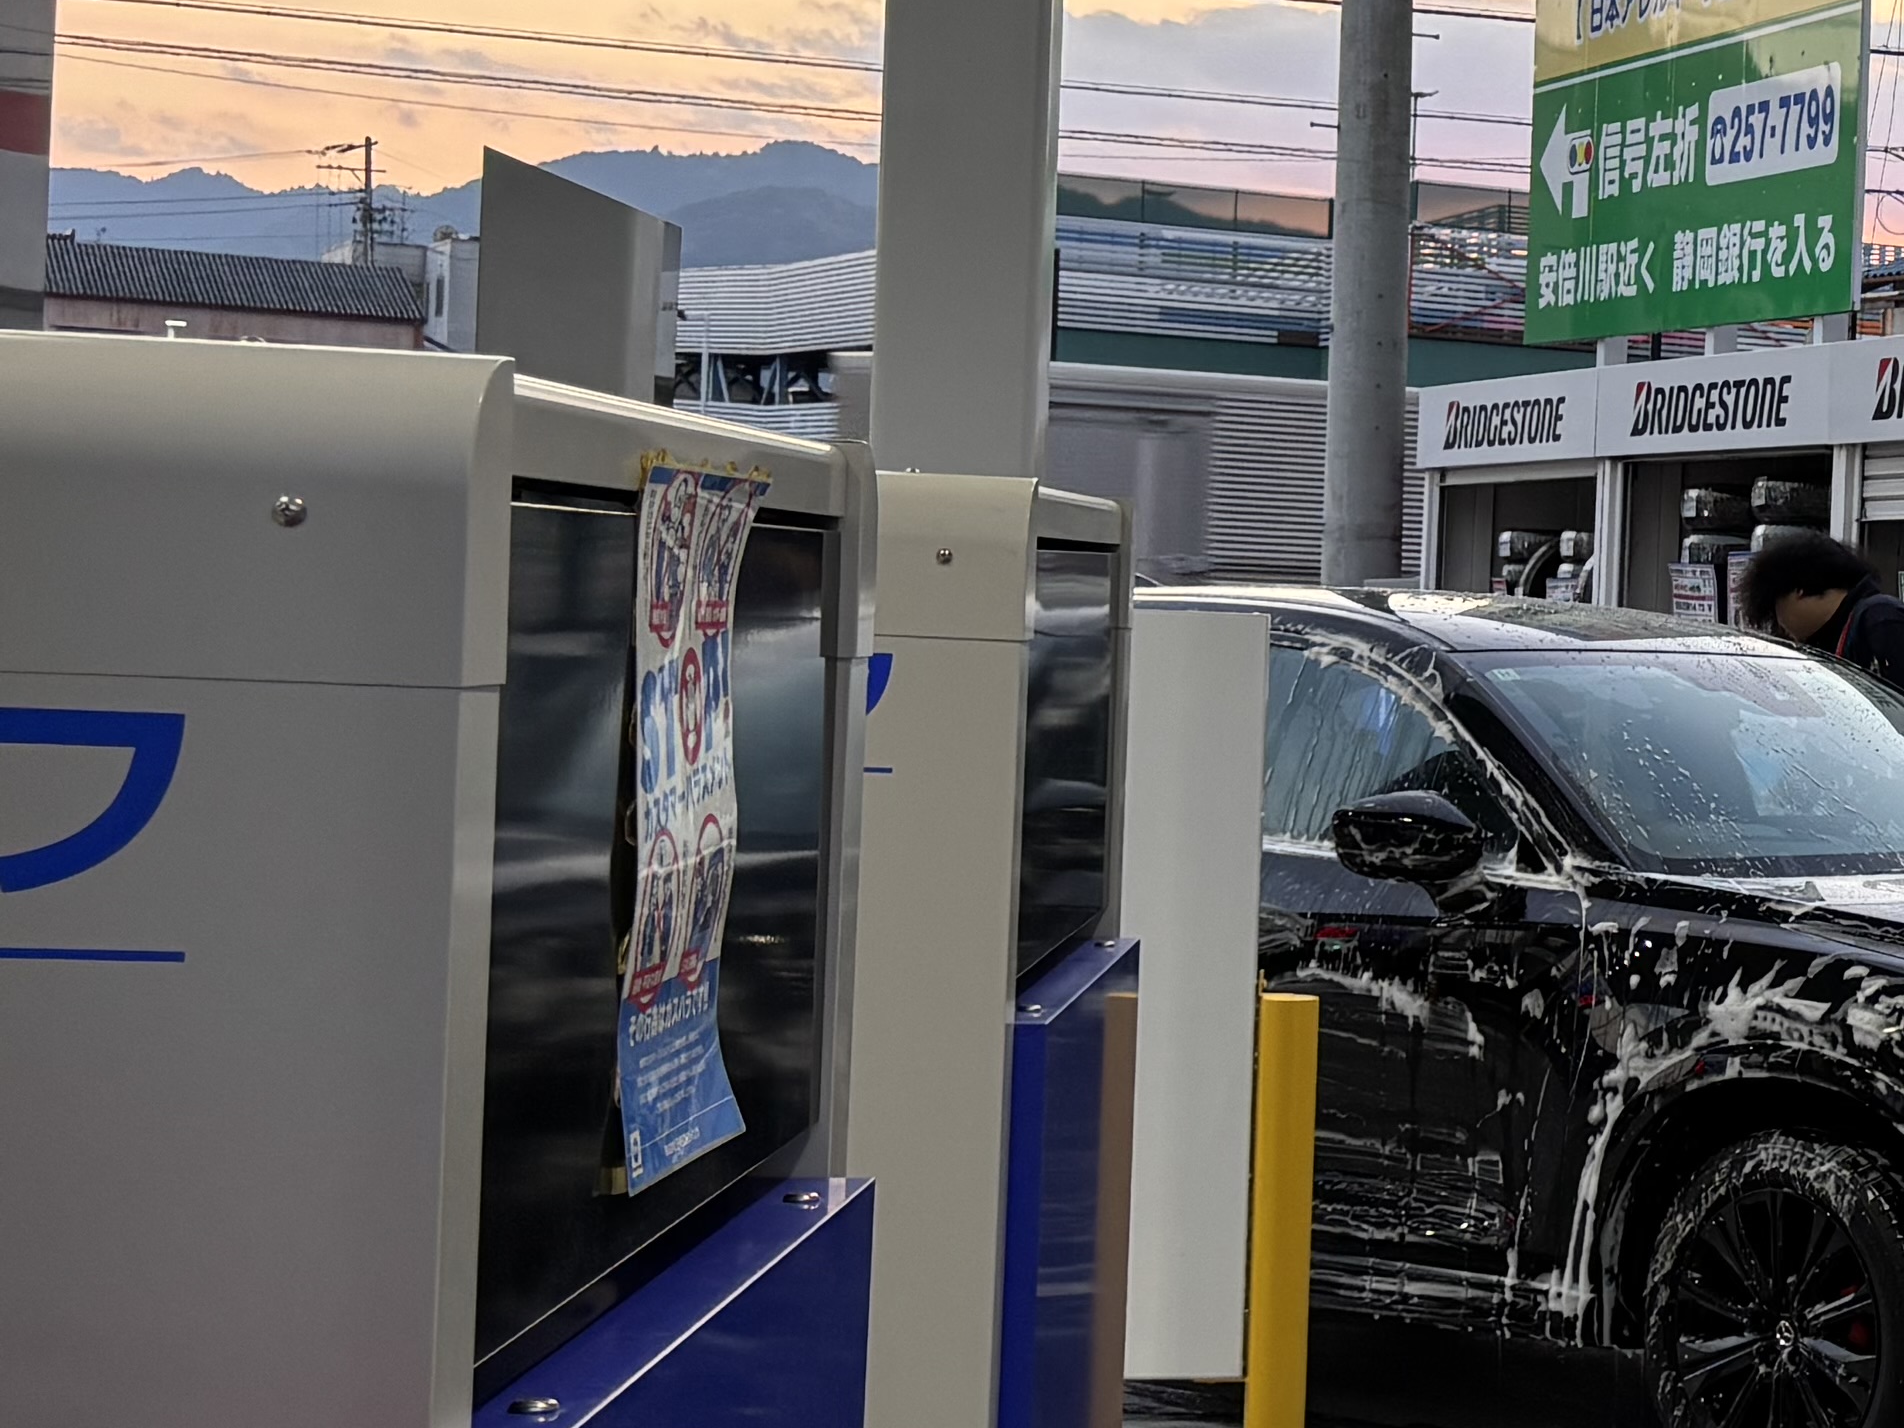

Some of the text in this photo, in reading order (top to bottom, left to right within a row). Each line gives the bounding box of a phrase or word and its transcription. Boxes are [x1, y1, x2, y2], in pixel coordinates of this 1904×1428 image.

[1598, 102, 1700, 200] 信号左折
[1728, 84, 1837, 165] 257-7799
[1538, 213, 1837, 309] 安倍川駅近く 静岡銀行を入る
[1443, 396, 1566, 450] BRIDGESTONE
[1630, 375, 1792, 437] BRIDGESTONE
